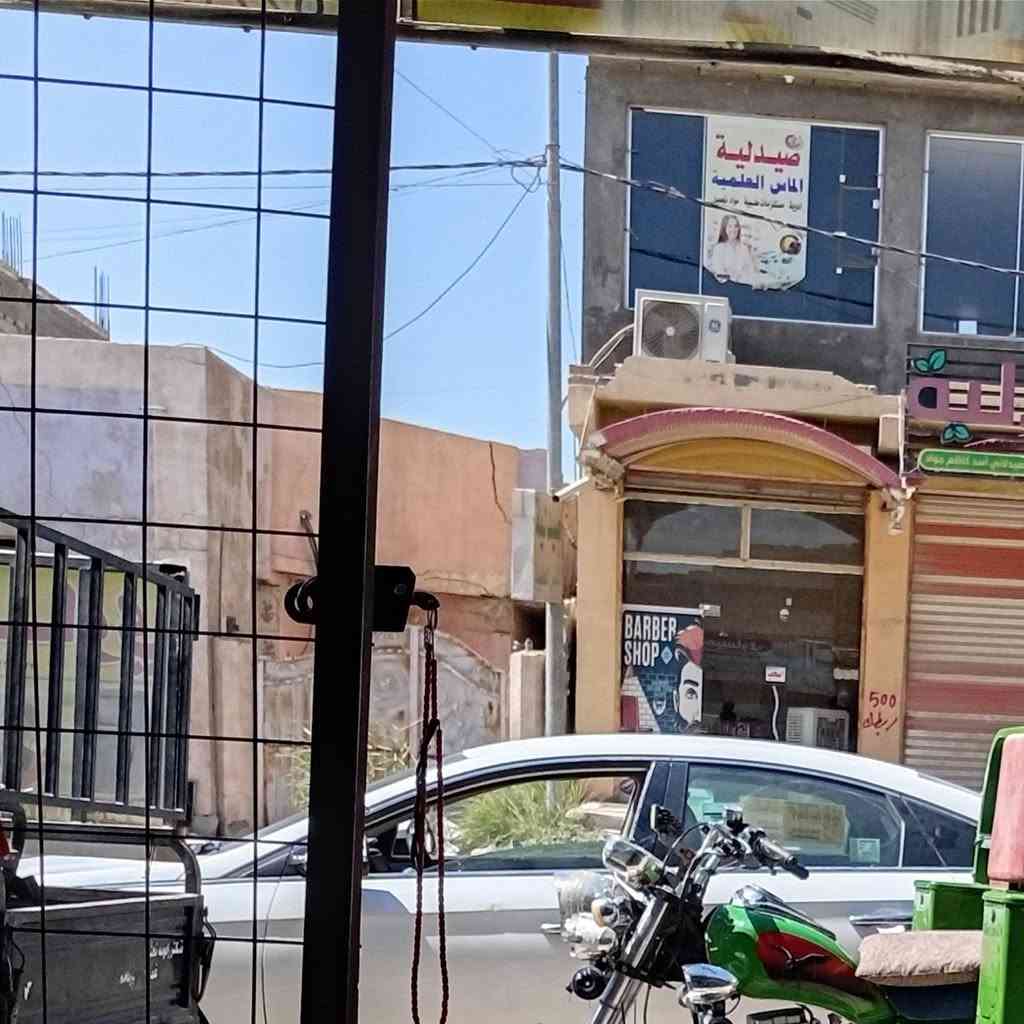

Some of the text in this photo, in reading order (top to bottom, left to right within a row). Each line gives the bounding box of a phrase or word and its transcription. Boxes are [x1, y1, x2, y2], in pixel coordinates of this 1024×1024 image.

[715, 133, 801, 173] صيدلية
[769, 177, 804, 195] الماس
[623, 613, 677, 642] BARBER
[623, 641, 660, 667] SHOP
[869, 691, 897, 708] 500
